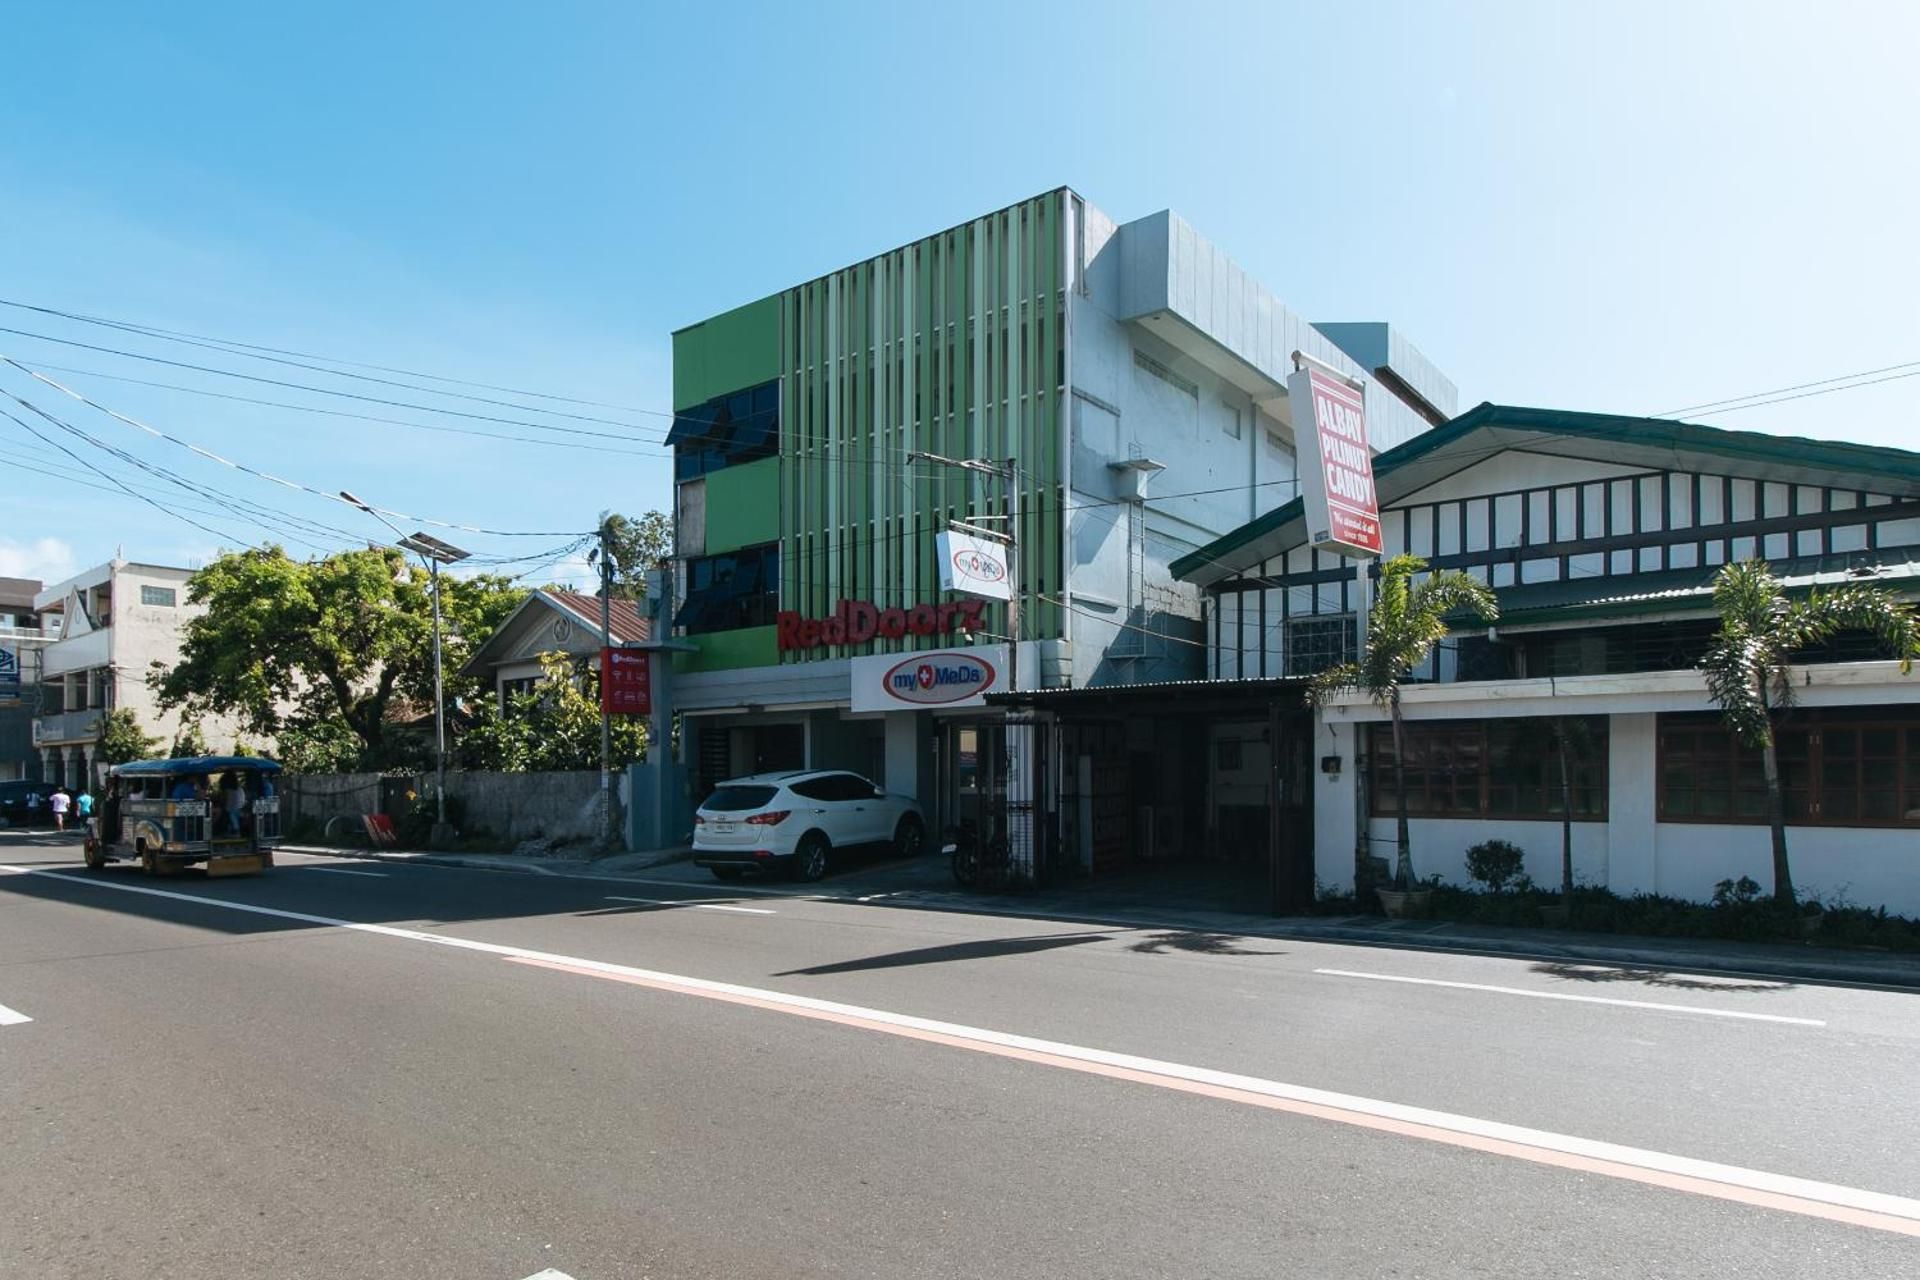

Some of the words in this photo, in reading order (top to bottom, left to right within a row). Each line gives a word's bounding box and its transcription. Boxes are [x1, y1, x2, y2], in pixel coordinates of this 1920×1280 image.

[1317, 395, 1363, 444] ALBAY
[1326, 461, 1372, 506] CANDY
[777, 598, 987, 650] RedDoorz
[894, 672, 916, 691] my
[935, 665, 981, 685] MeDs
